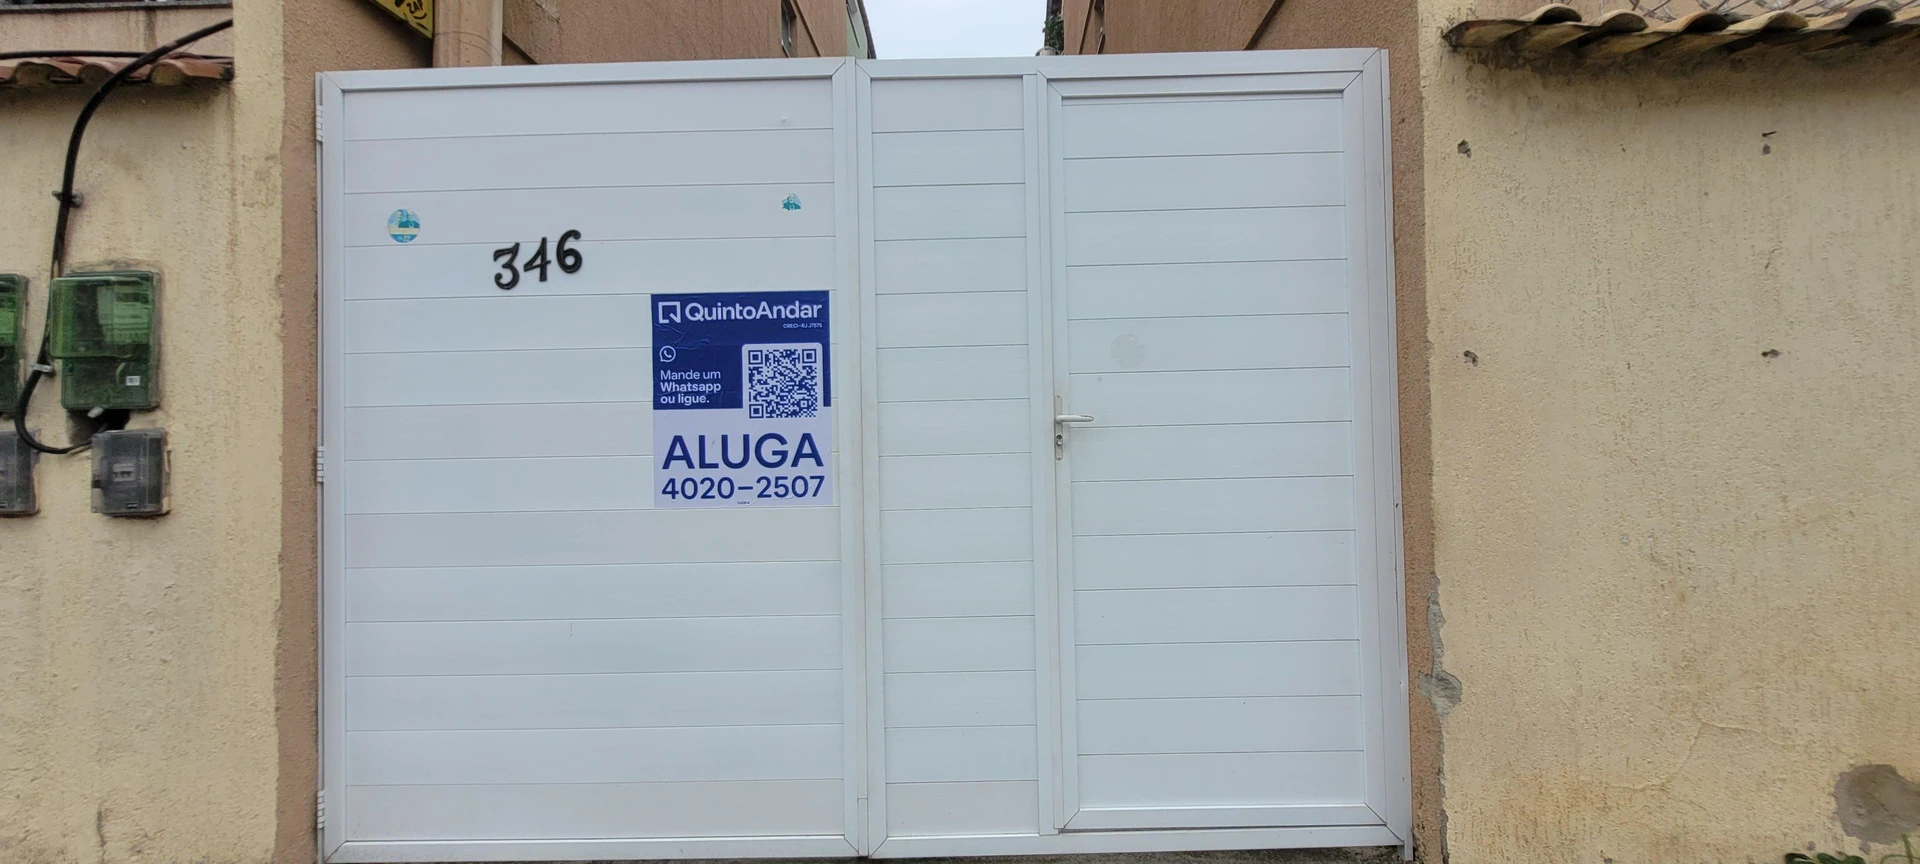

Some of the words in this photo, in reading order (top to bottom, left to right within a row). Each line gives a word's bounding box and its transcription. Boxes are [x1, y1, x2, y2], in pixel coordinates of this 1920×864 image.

[493, 229, 583, 290] 346
[685, 301, 823, 322] QuintoAndar
[660, 370, 701, 381] Mande
[702, 371, 721, 380] um
[660, 381, 722, 393] Whatsapp
[660, 395, 675, 404] ou
[677, 393, 710, 406] ligue.
[662, 433, 824, 469] ALUGA
[661, 475, 825, 500] 4020-2507
